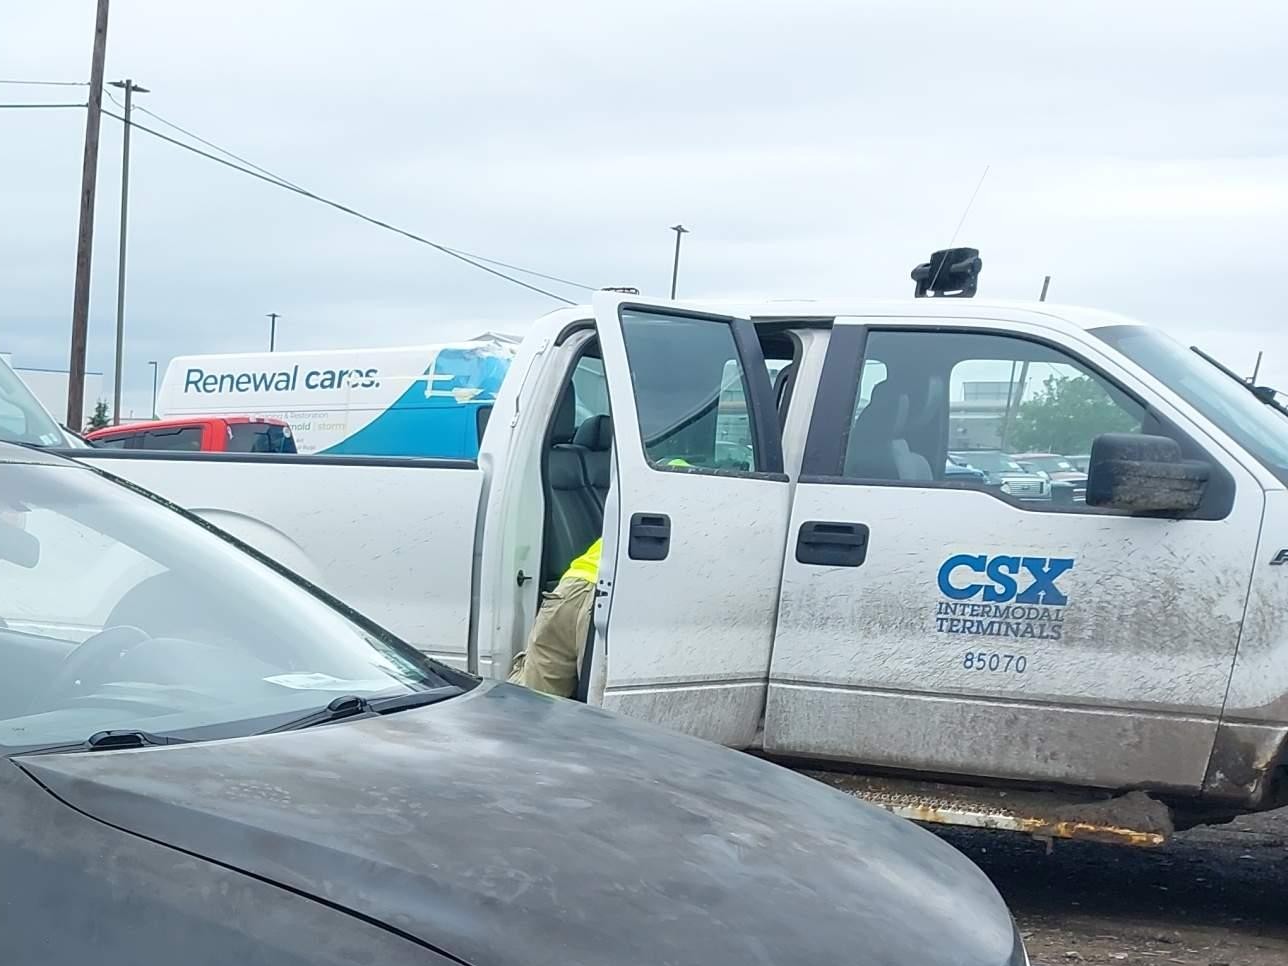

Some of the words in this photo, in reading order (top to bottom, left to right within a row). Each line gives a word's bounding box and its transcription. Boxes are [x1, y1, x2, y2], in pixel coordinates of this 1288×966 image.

[184, 365, 299, 393] Renewal
[937, 554, 1074, 606] CSX
[936, 601, 1065, 622] INTERMODAL
[936, 617, 1063, 640] TERMINALS
[963, 651, 1027, 674] 85070
